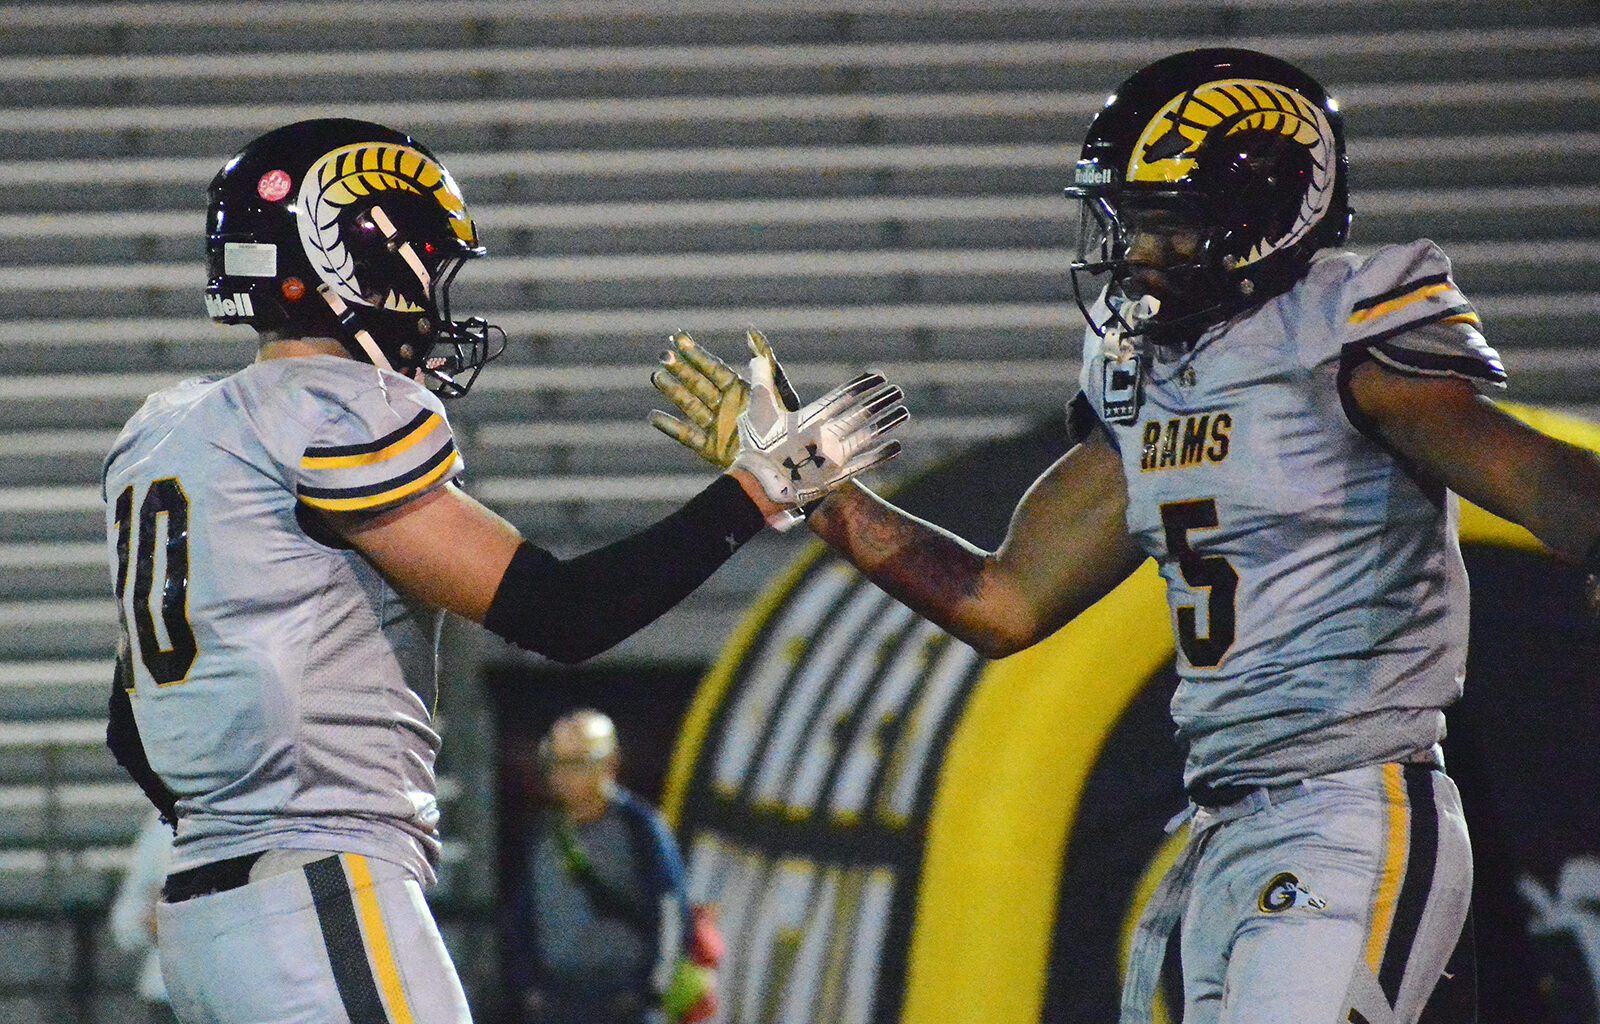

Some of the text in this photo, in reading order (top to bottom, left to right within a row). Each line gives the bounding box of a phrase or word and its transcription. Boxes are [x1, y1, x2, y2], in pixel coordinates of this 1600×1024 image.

[1105, 359, 1137, 403] C
[1141, 411, 1233, 473] RAMS
[114, 476, 198, 693] 10
[1159, 497, 1241, 669] 5
